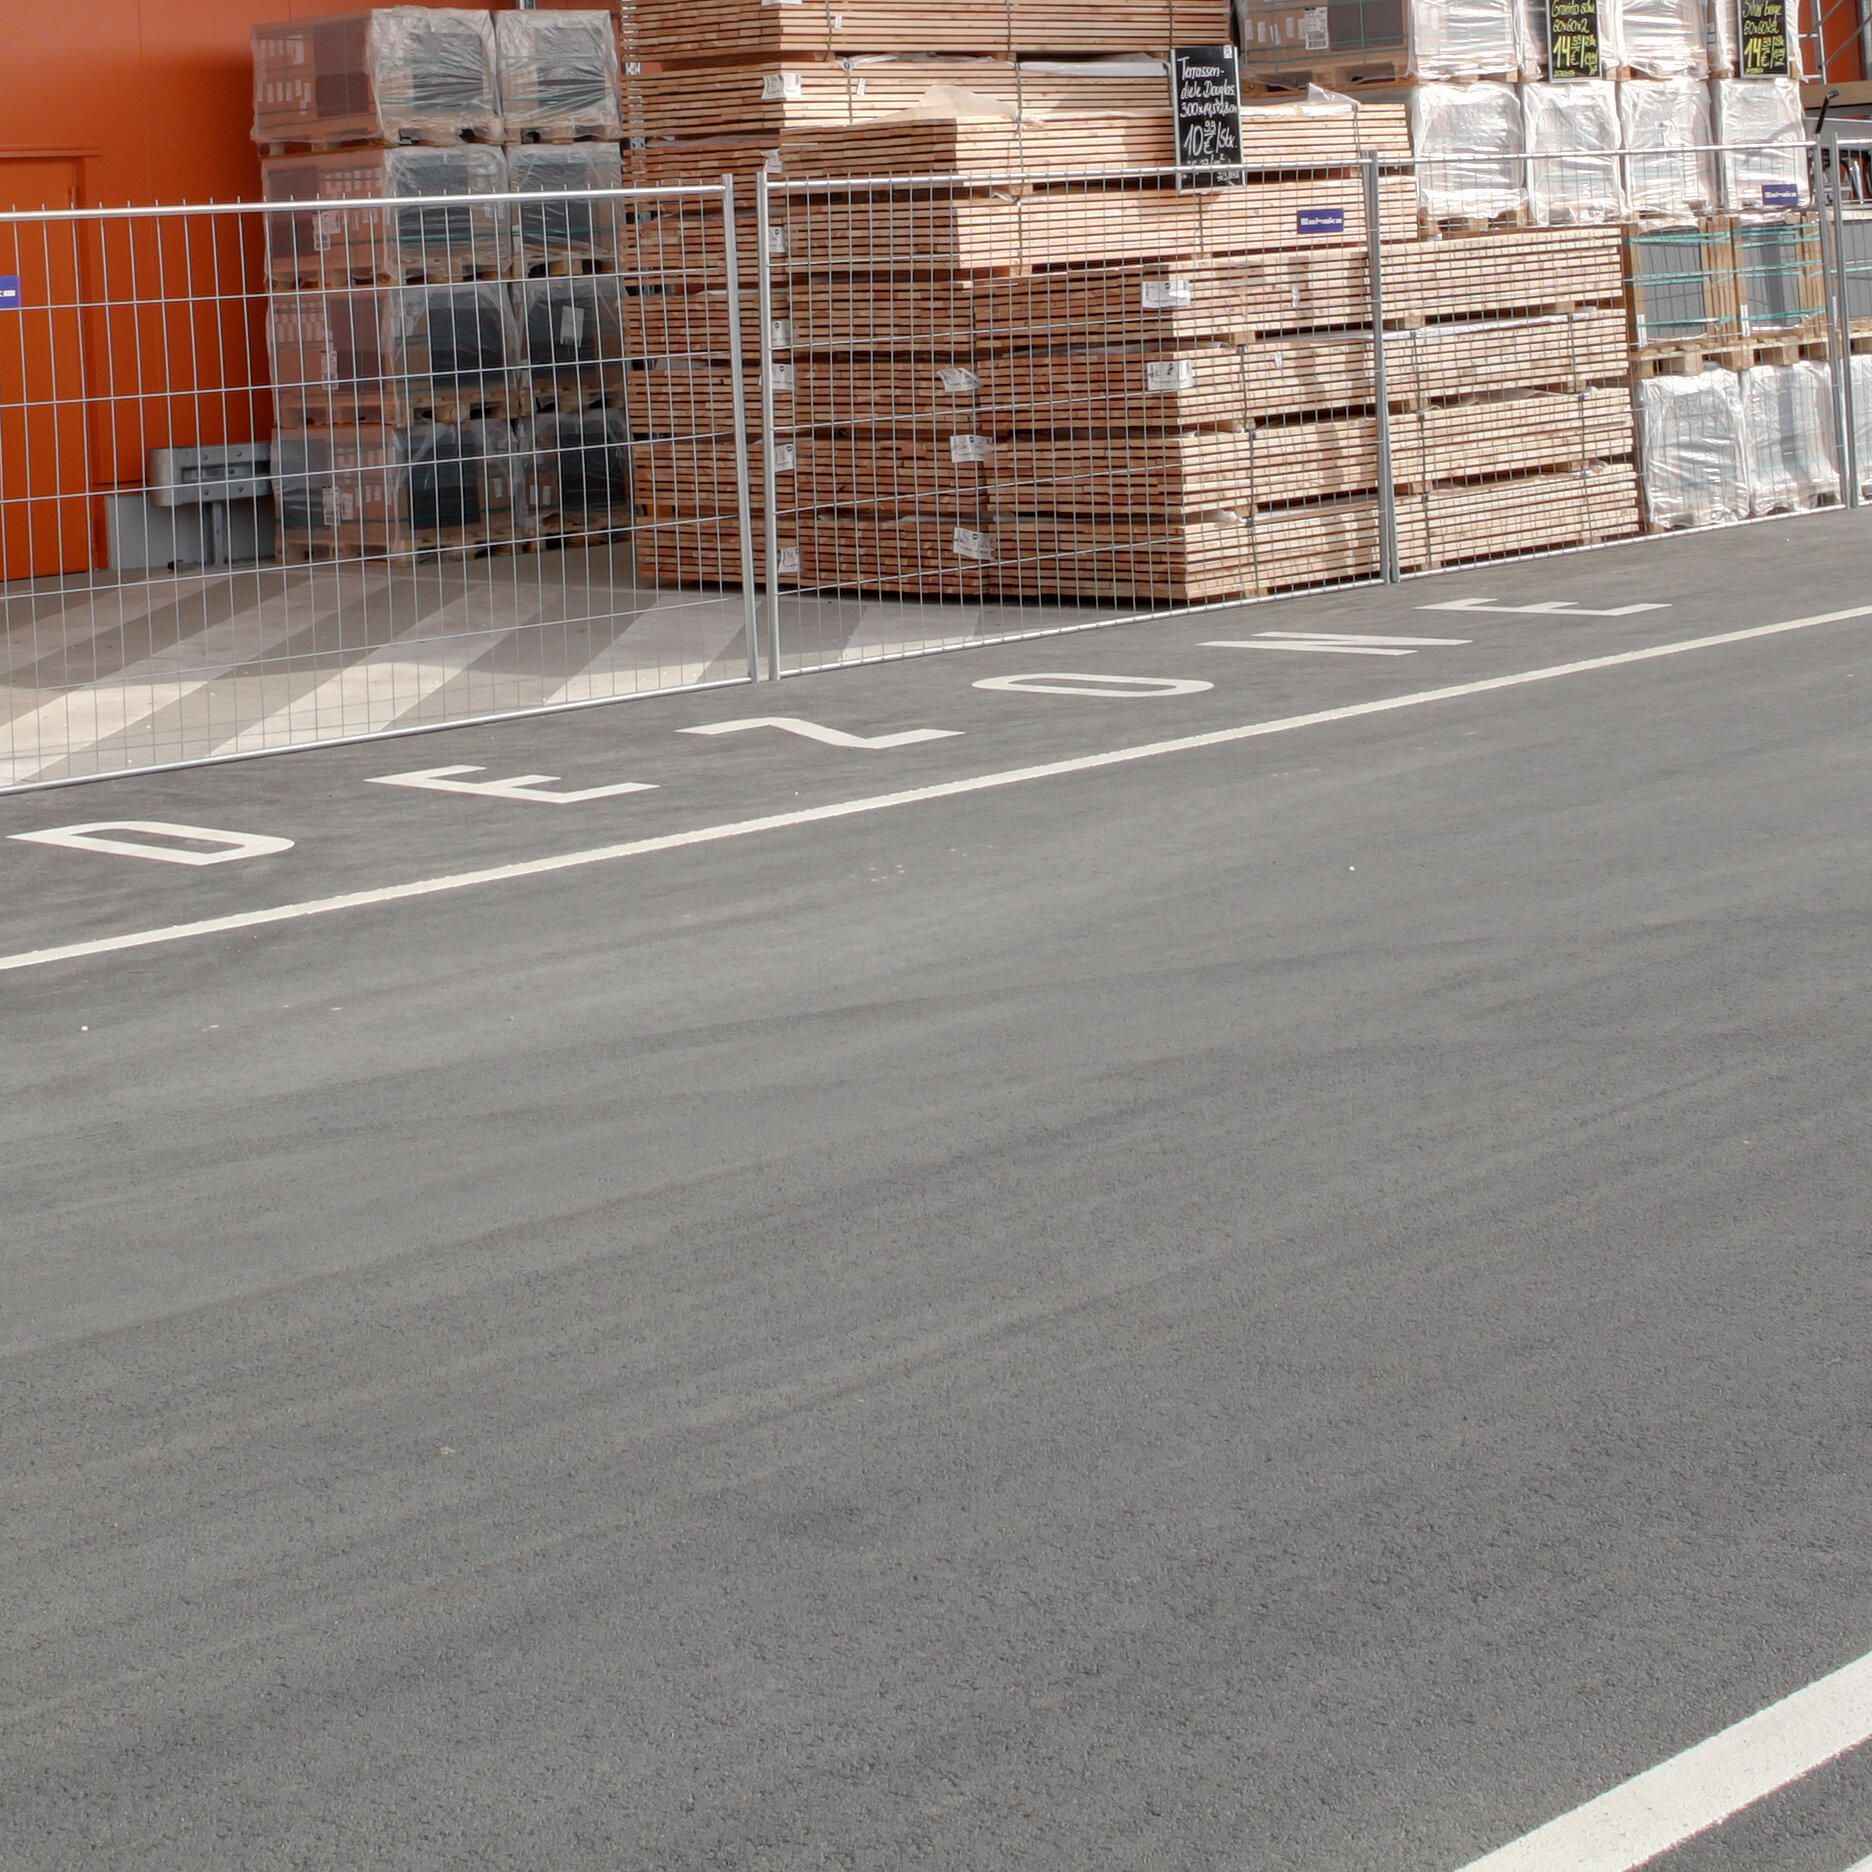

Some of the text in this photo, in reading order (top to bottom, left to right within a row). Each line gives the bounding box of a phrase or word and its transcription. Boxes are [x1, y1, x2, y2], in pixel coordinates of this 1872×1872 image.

[1553, 35, 1570, 68] 14
[1744, 38, 1761, 67] 14
[1184, 123, 1203, 156] 10
